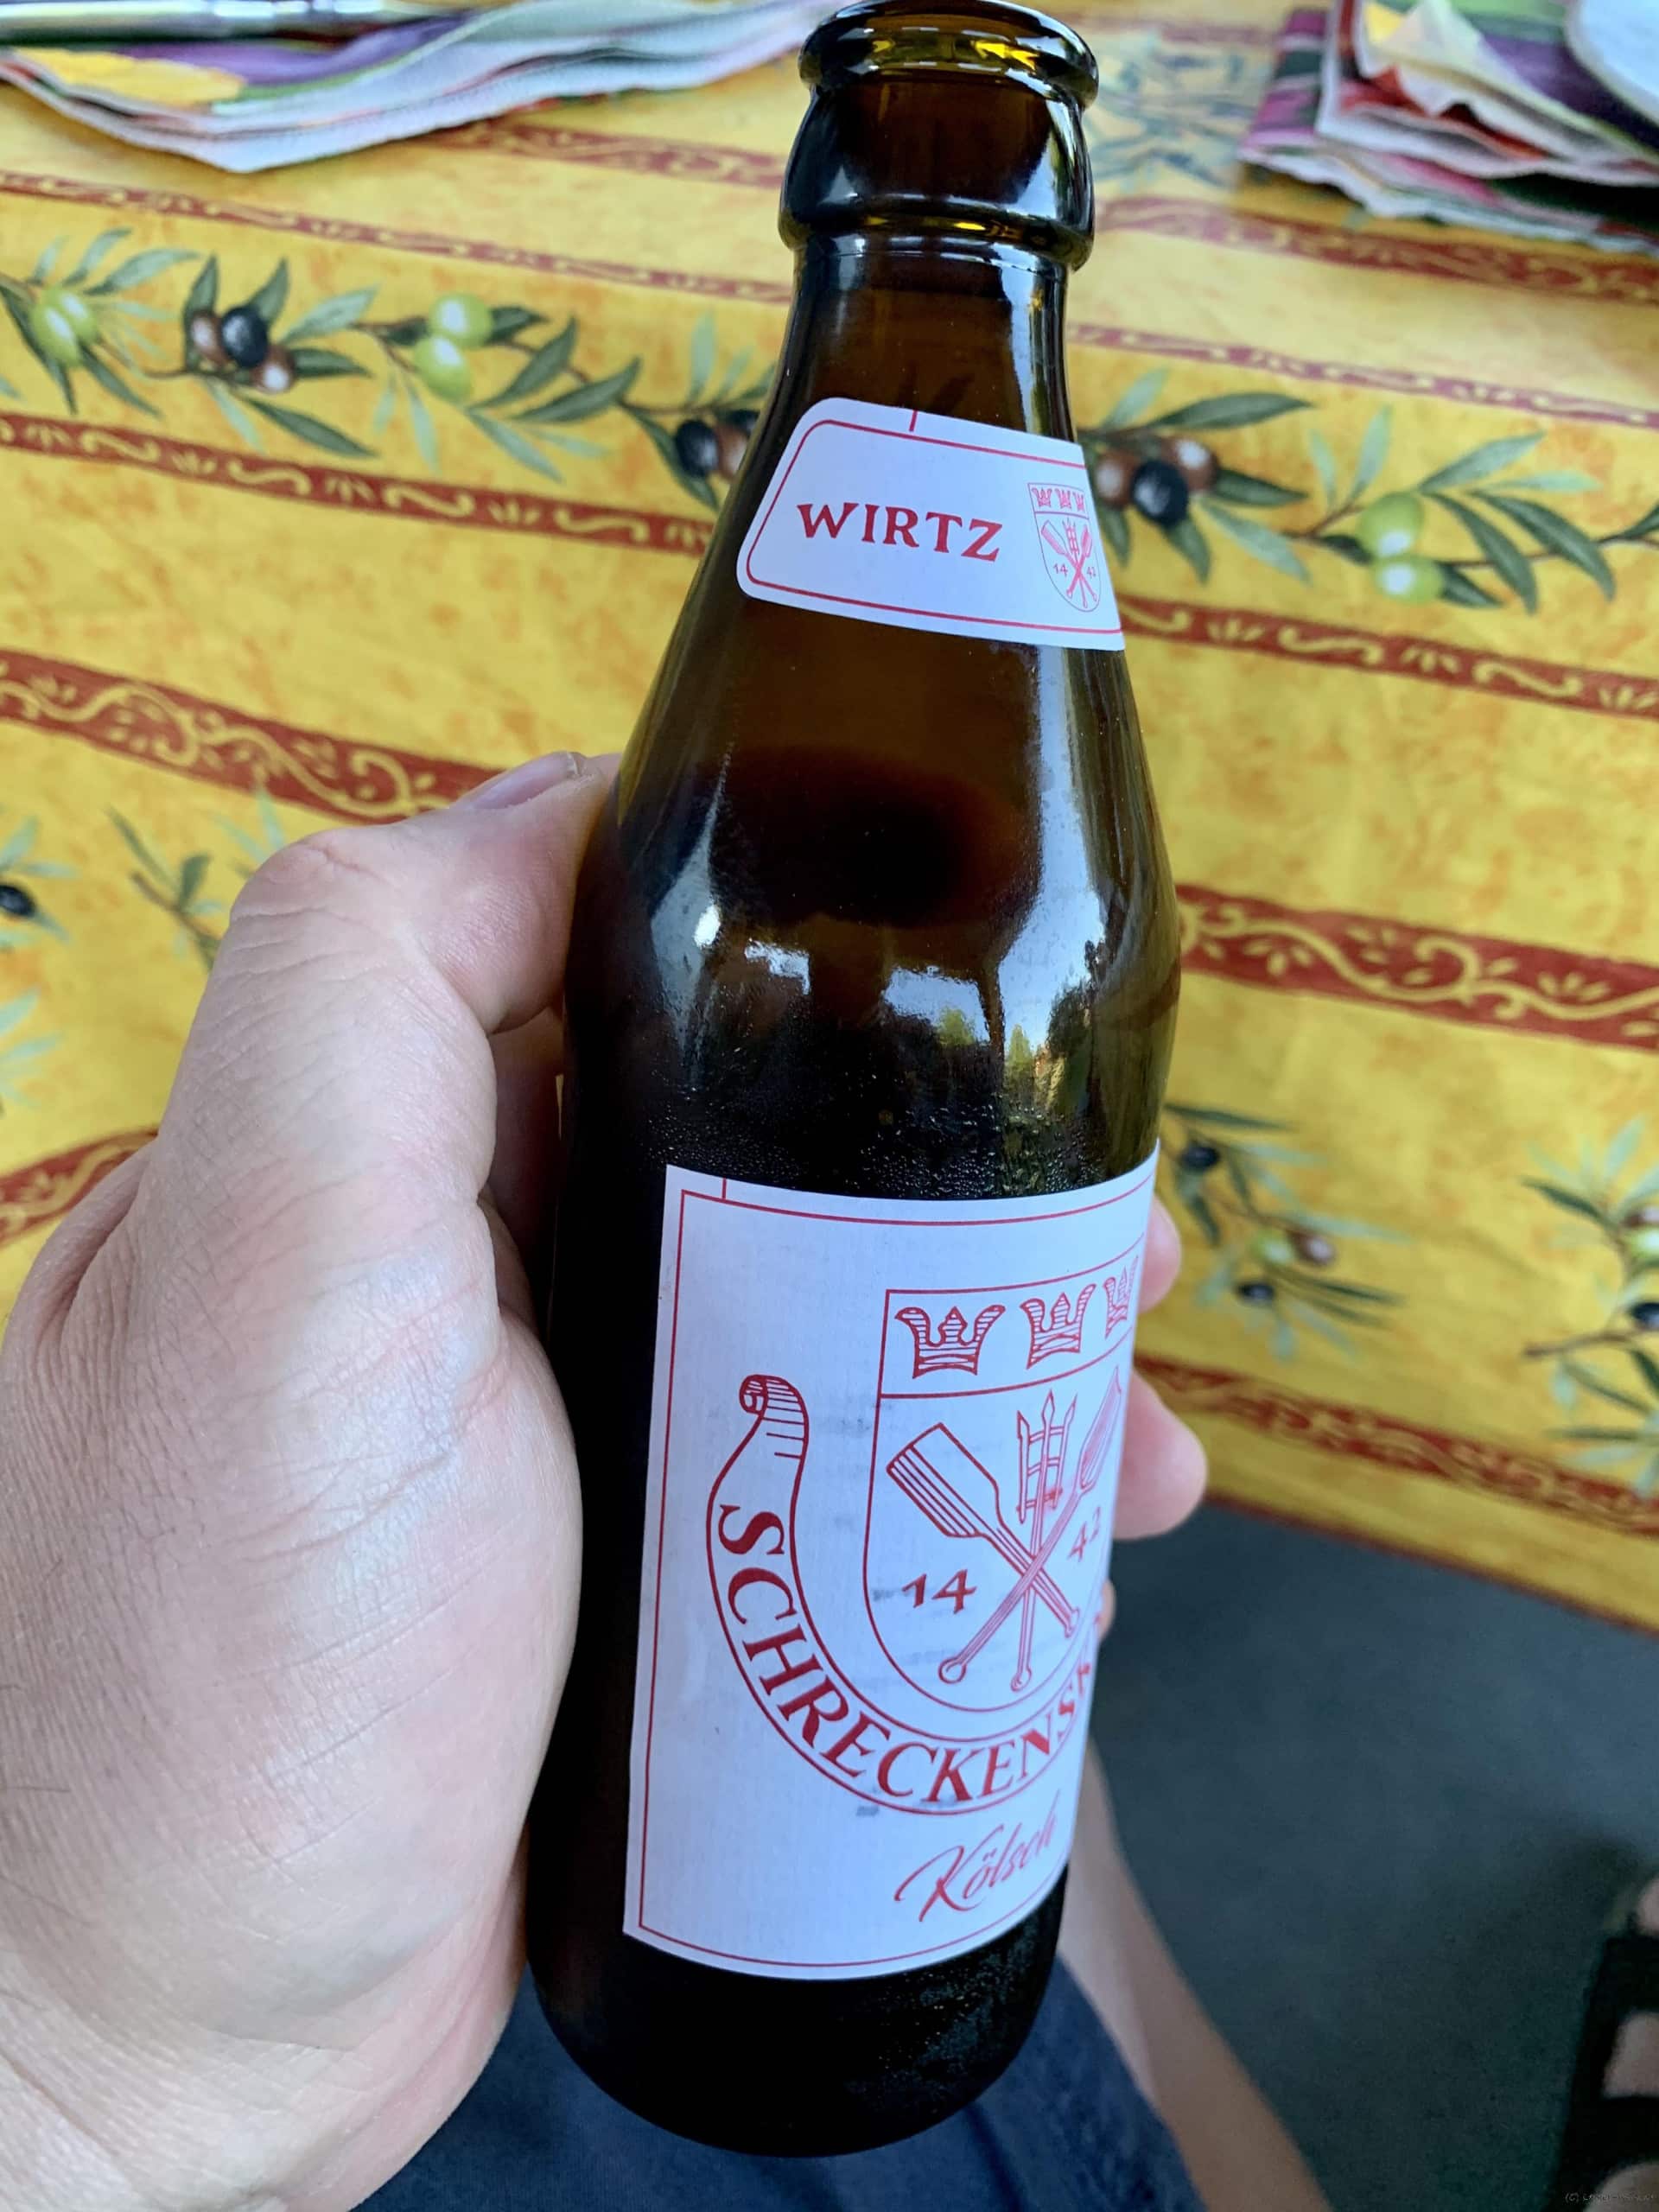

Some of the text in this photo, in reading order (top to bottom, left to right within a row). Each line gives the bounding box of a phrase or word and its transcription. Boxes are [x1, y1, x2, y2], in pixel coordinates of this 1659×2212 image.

[797, 502, 1003, 563] WIRTZ
[1052, 563, 1069, 577] 14
[900, 1568, 977, 1614] 14
